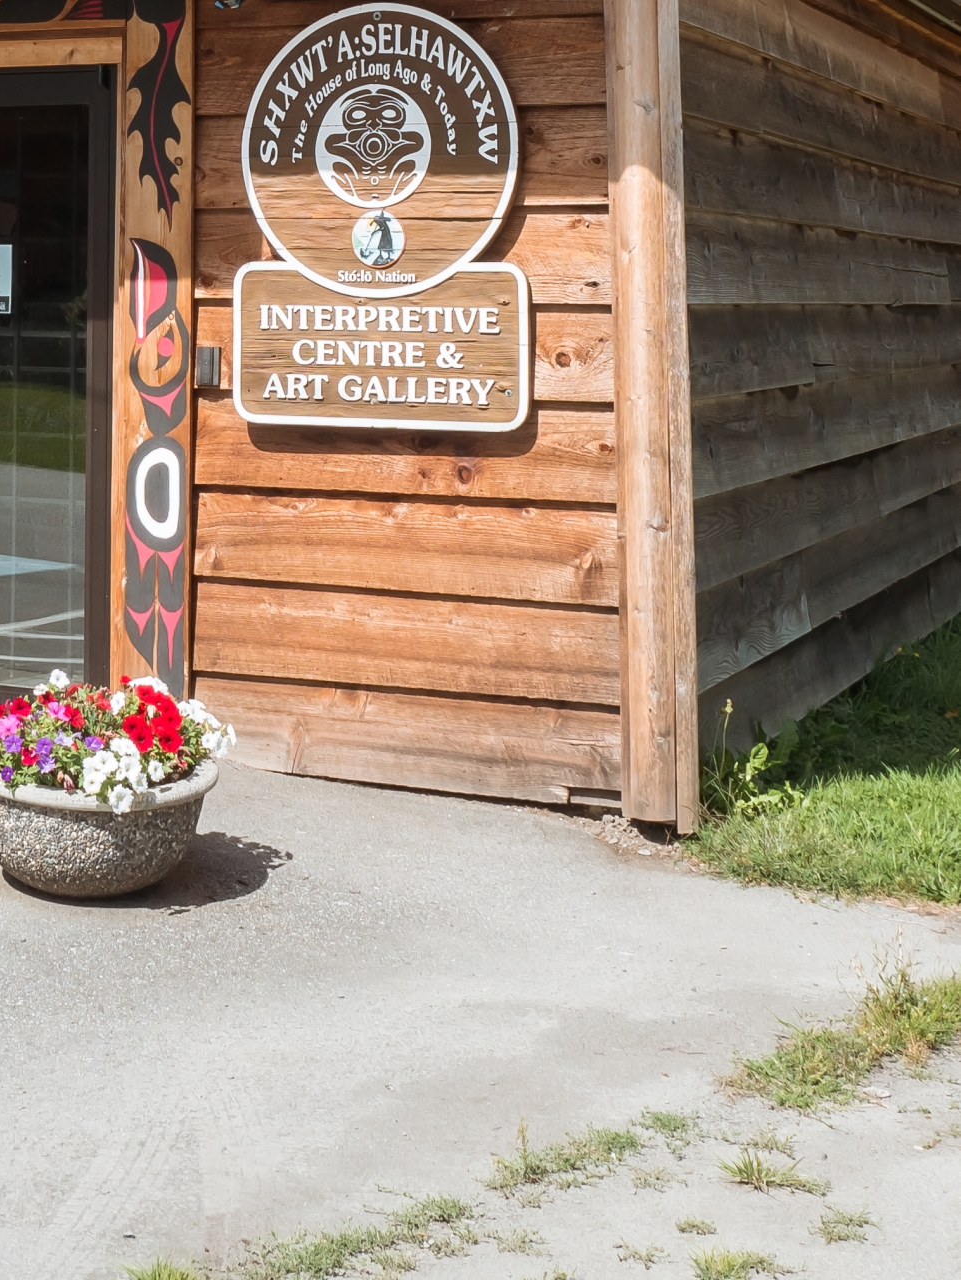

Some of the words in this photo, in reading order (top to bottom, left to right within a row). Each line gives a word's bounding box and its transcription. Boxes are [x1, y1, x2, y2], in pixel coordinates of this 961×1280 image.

[291, 119, 308, 164] The
[304, 73, 343, 118] House
[345, 60, 358, 82] of
[360, 58, 391, 80] Long
[393, 59, 418, 85] Ago
[420, 72, 432, 95] &
[434, 85, 457, 156] Today
[337, 269, 373, 283] Stó:lō
[375, 269, 416, 283] Nation
[258, 303, 501, 335] INTERPRETIVE
[291, 338, 426, 368] CENTRE
[435, 341, 465, 370] &
[262, 372, 330, 400] ART
[336, 374, 496, 406] GALLERY
